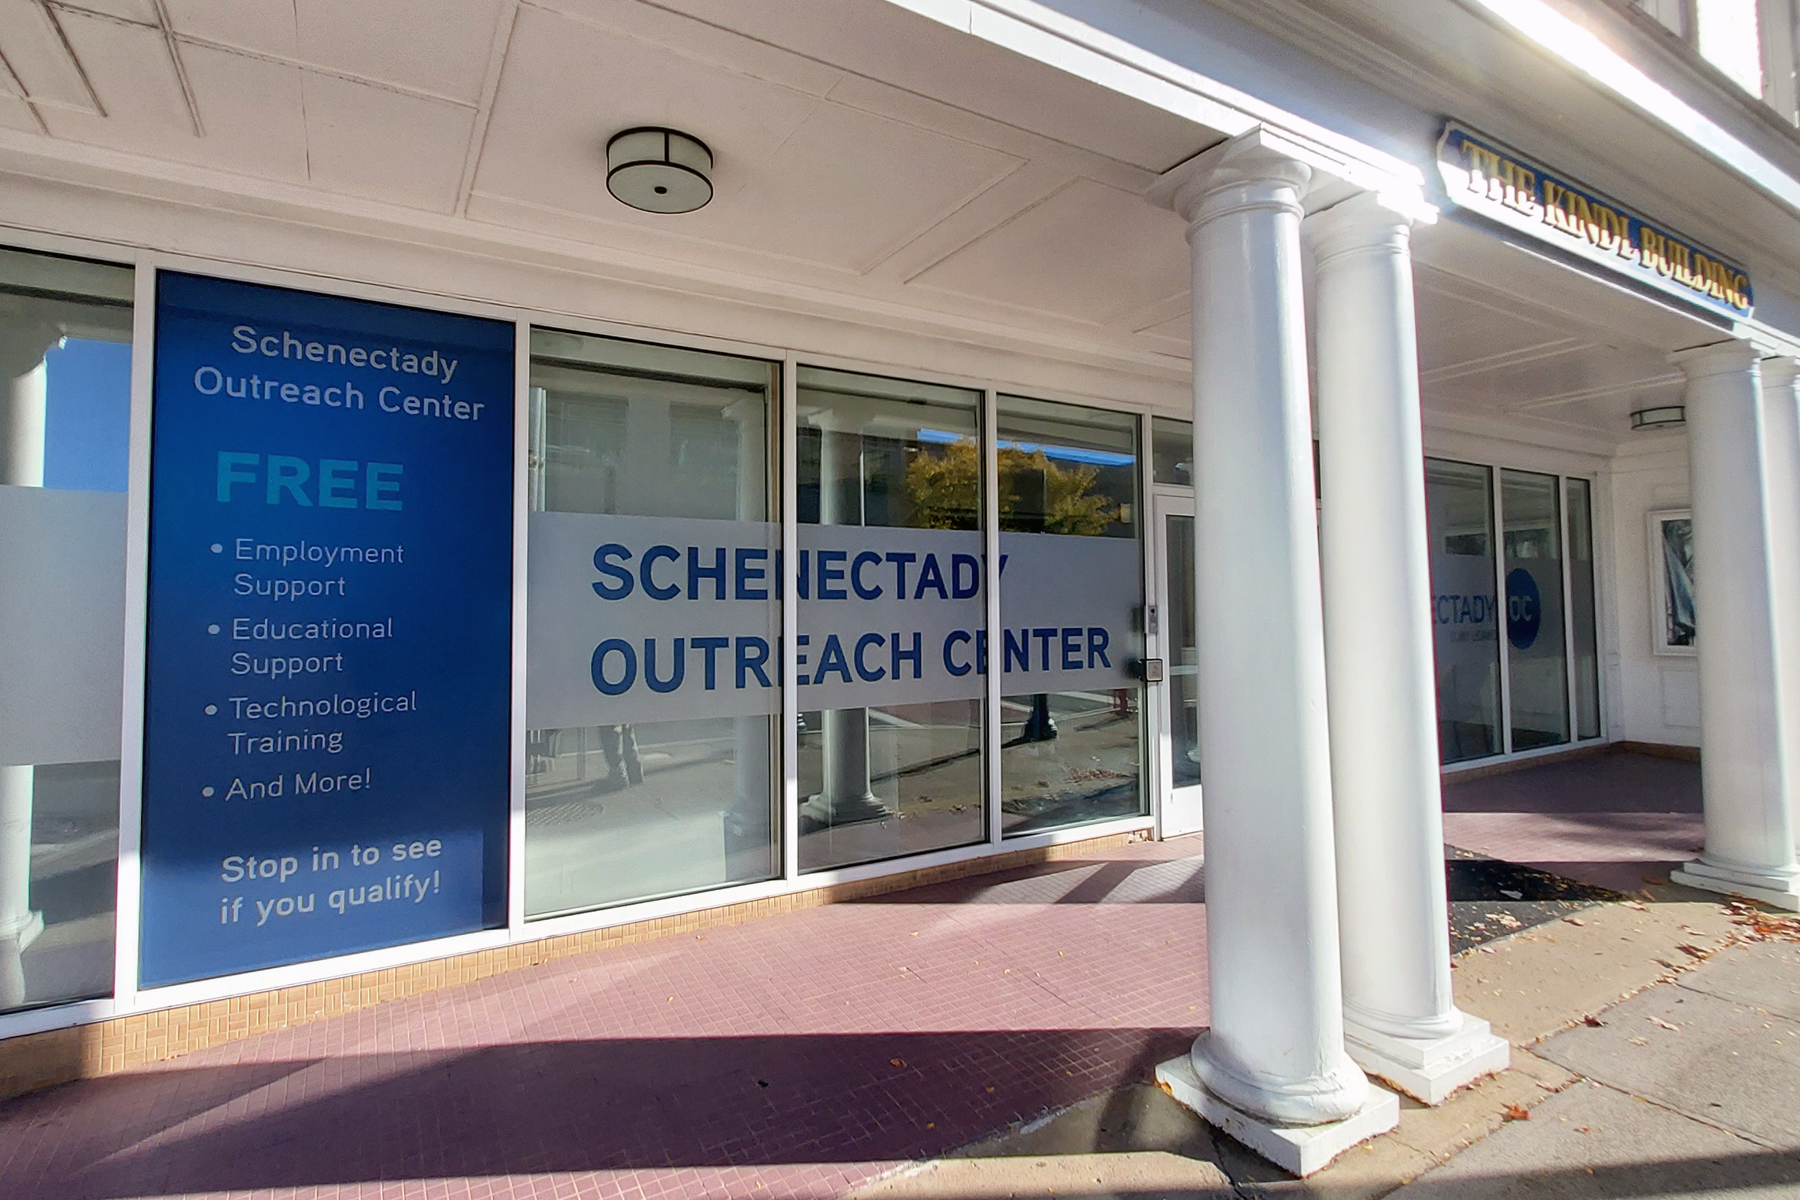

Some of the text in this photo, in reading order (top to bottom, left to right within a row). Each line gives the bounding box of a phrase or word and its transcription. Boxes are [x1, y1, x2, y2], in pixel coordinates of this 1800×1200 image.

[1461, 139, 1749, 310] THE KINDL BUILDING
[230, 324, 458, 385] Schenectady
[193, 365, 485, 421] Outreach Center
[216, 450, 404, 511] FREE
[235, 538, 405, 567] Employment
[233, 573, 346, 601] Support
[232, 617, 393, 641] Educational
[230, 651, 344, 679] Support
[591, 631, 922, 696] OUTREACH
[228, 690, 418, 720] Technological
[227, 728, 343, 755] Training
[224, 767, 371, 801] And More!
[220, 839, 442, 883] Stop in to see
[220, 870, 441, 927] if you qualify!
